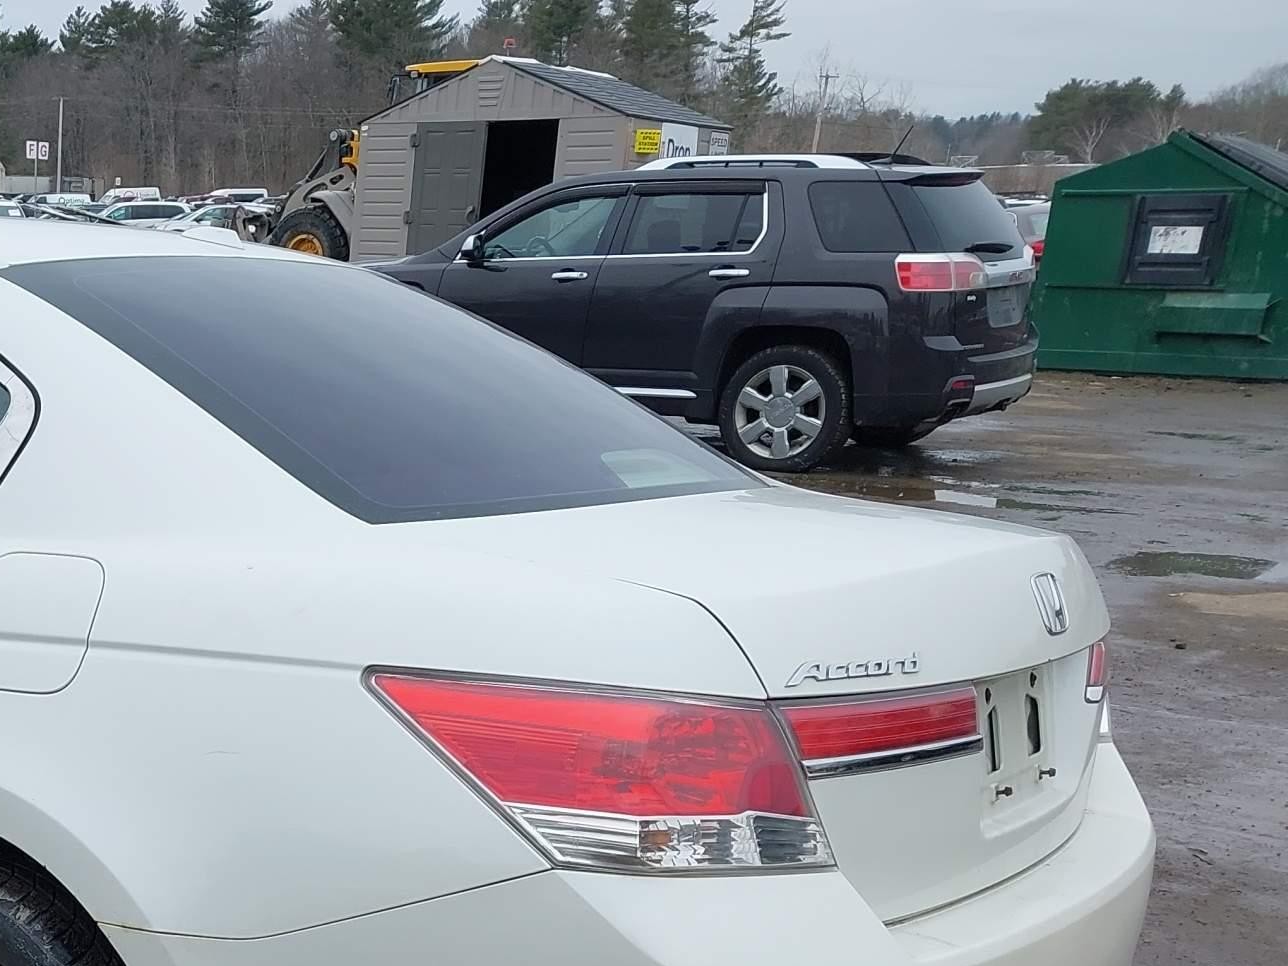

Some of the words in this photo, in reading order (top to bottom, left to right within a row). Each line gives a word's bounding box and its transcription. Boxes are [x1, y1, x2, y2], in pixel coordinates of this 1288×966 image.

[711, 137, 728, 147] SPEED
[29, 143, 35, 157] F
[40, 144, 48, 158] G
[784, 652, 920, 688] Accord
